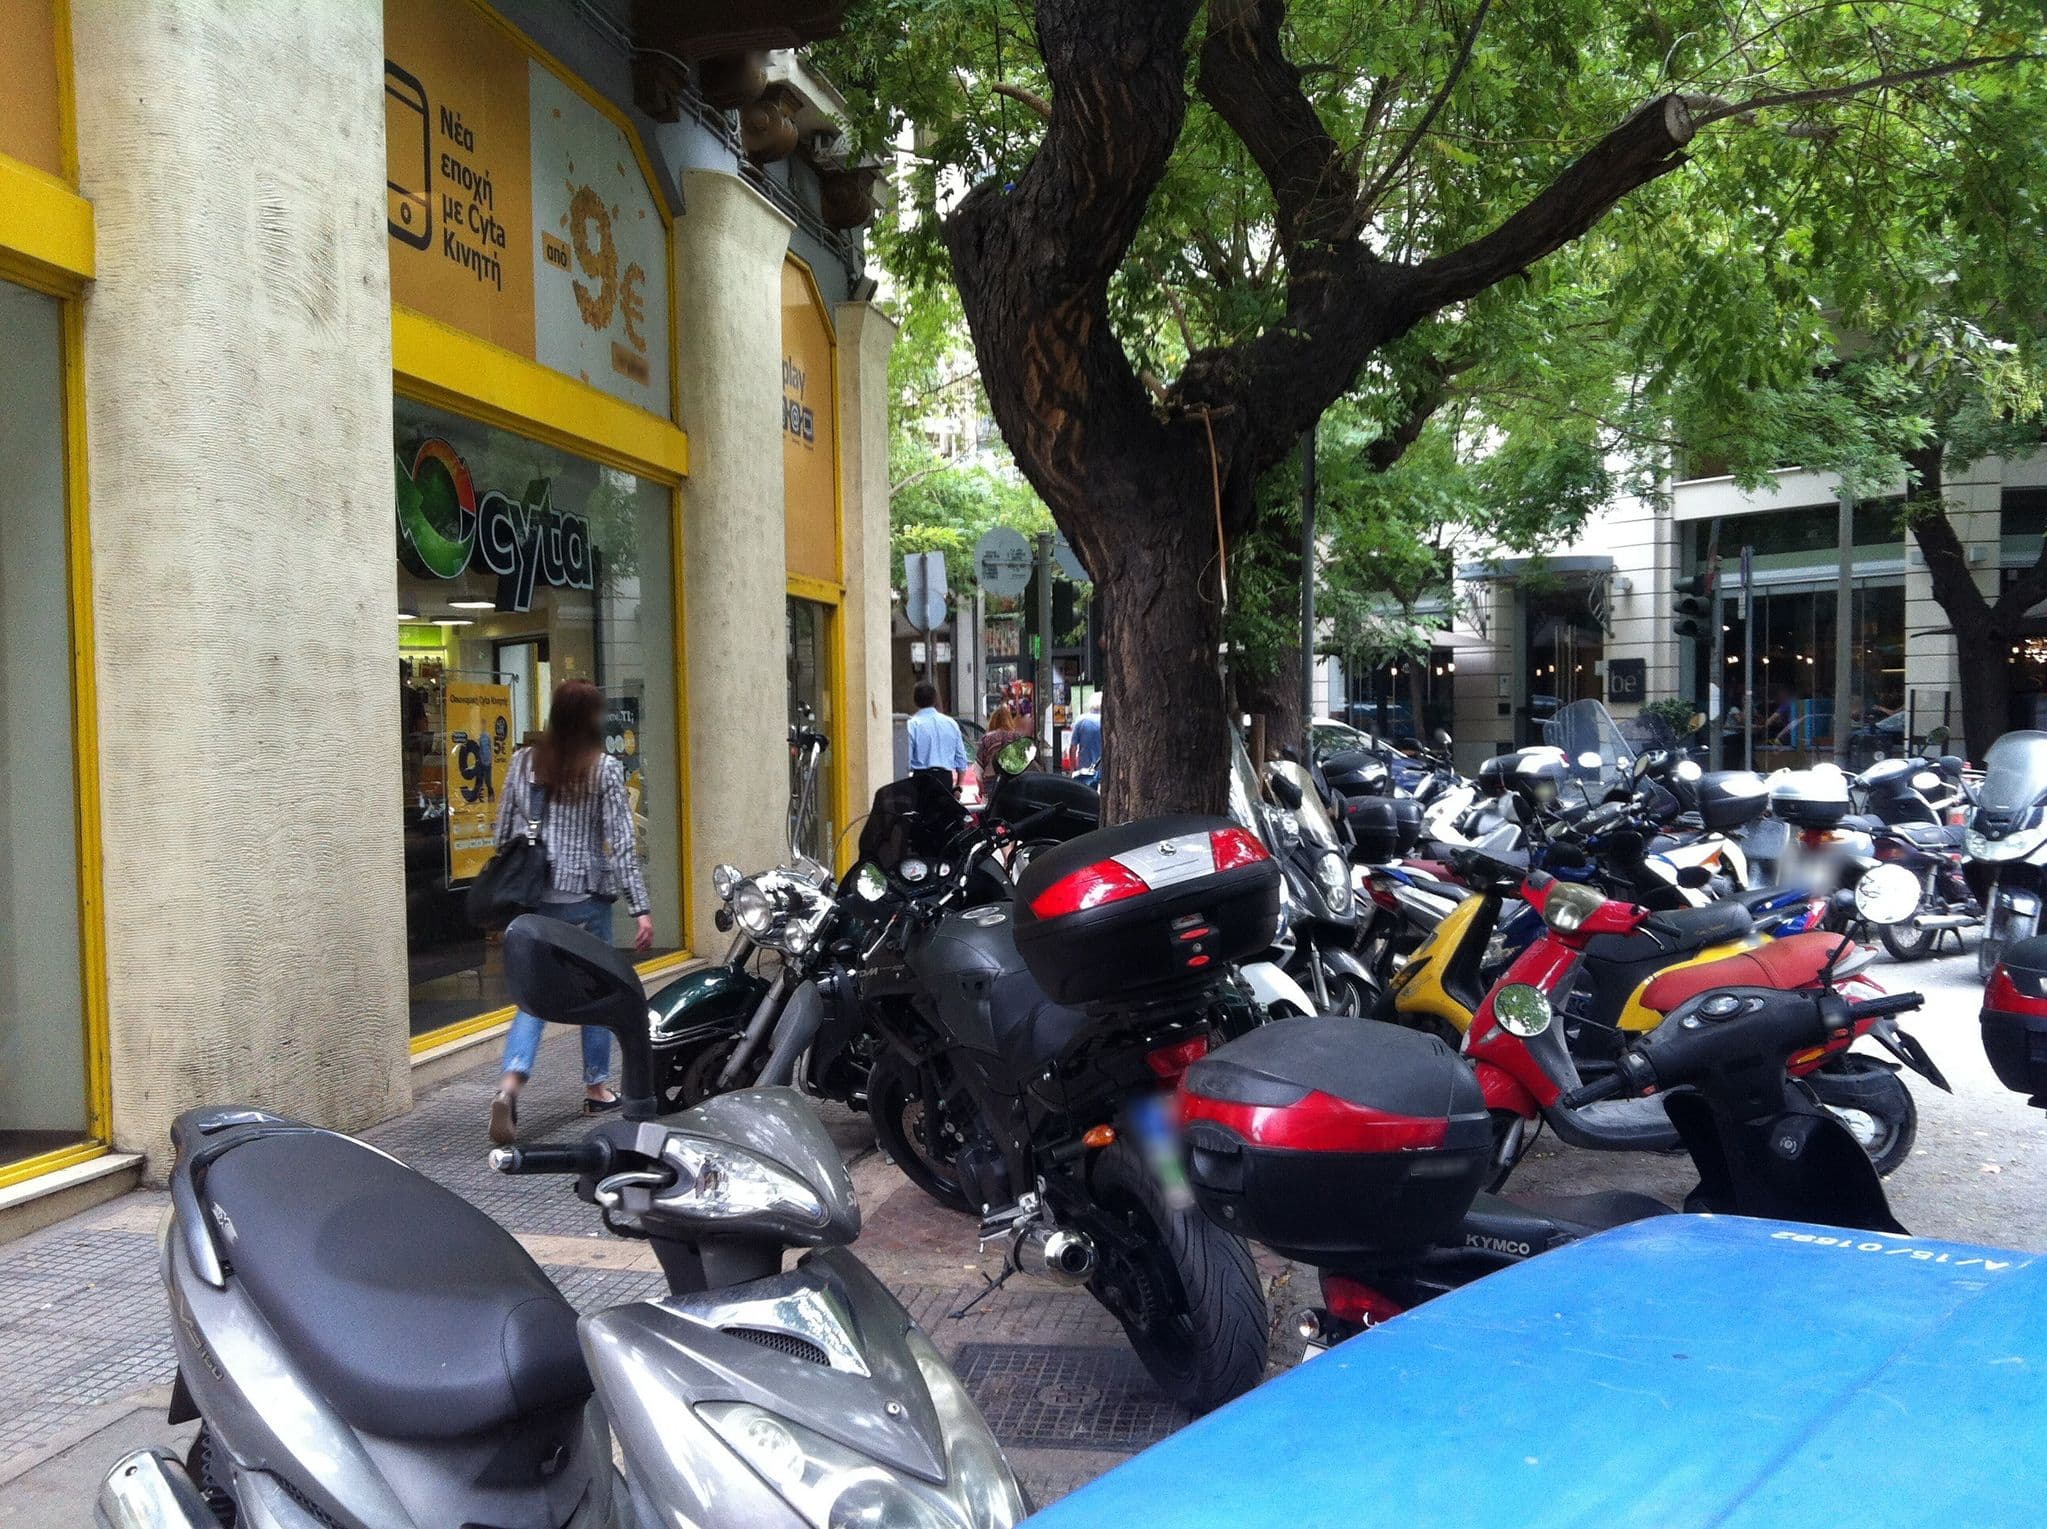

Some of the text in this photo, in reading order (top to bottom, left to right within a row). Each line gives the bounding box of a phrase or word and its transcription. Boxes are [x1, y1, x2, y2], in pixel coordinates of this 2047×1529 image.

[440, 104, 474, 154] Νέα
[441, 153, 492, 211] εποχή
[442, 192, 506, 249] με Cyta
[443, 226, 501, 292] Κινητή
[546, 243, 568, 268] από
[478, 477, 595, 612] cyta
[1465, 1233, 1530, 1255] KYMCO
